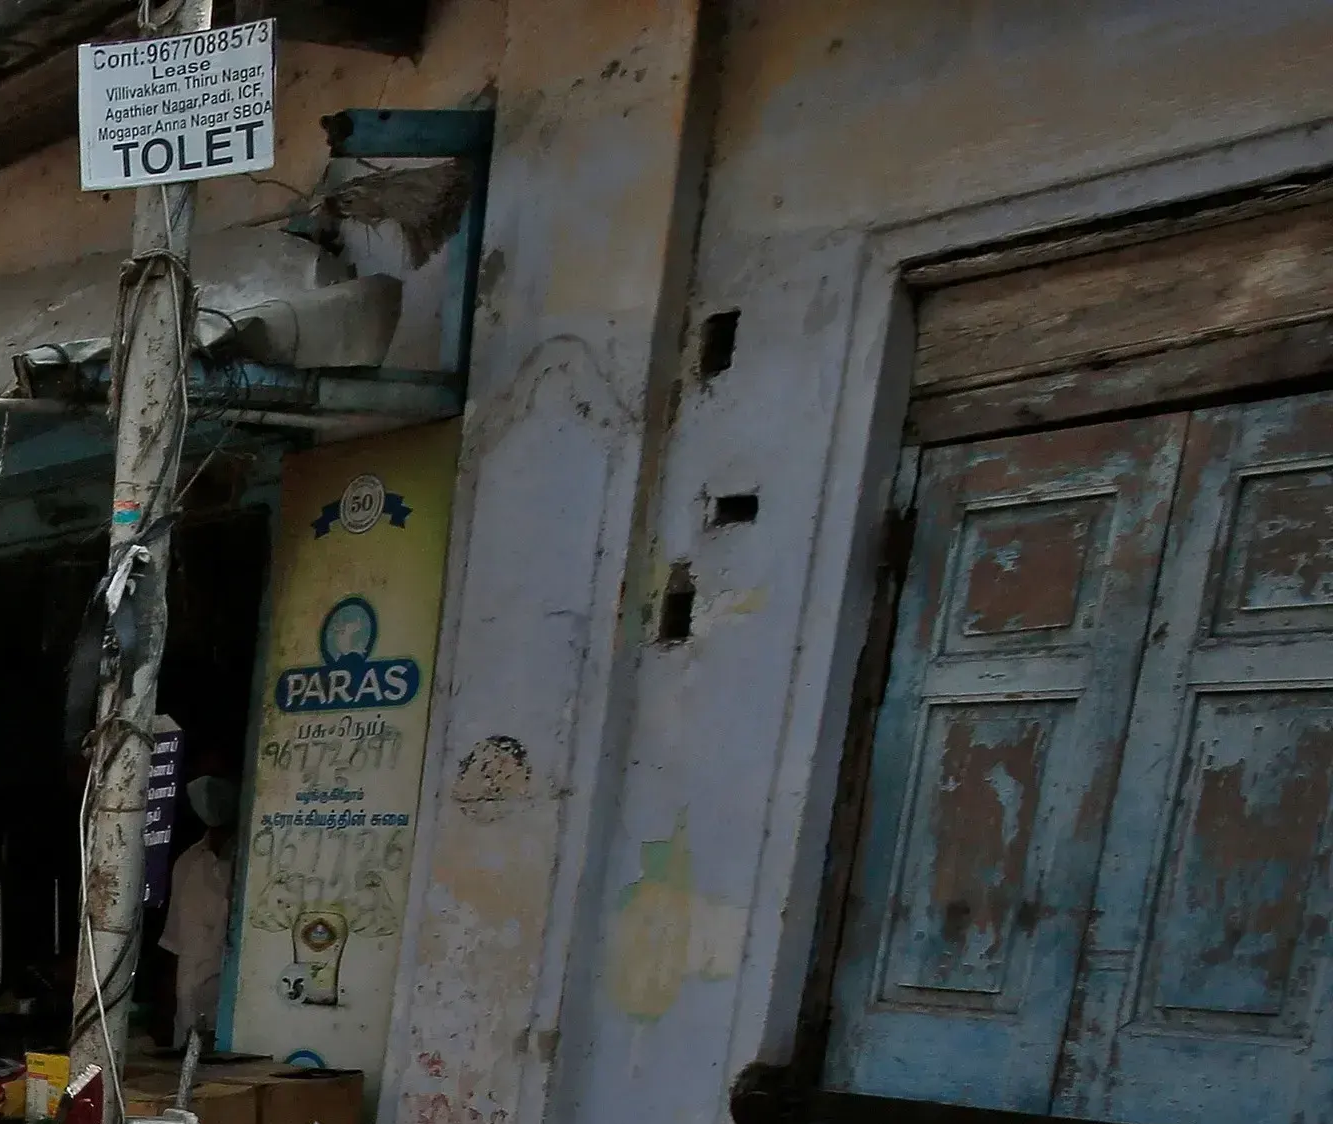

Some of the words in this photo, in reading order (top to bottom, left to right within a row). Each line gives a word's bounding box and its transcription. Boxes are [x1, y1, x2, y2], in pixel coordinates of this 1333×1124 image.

[94, 21, 268, 70] Cont:9677088573
[153, 60, 210, 79] Lease
[185, 73, 218, 90] Thiru
[222, 65, 266, 83] Nagar,
[106, 104, 158, 122] Agathier
[238, 83, 264, 98] ICF,
[191, 111, 229, 128] Nagar
[233, 100, 273, 119] SBOA
[113, 120, 264, 177] TOLET
[351, 493, 374, 514] 50
[286, 665, 409, 707] PARAS
